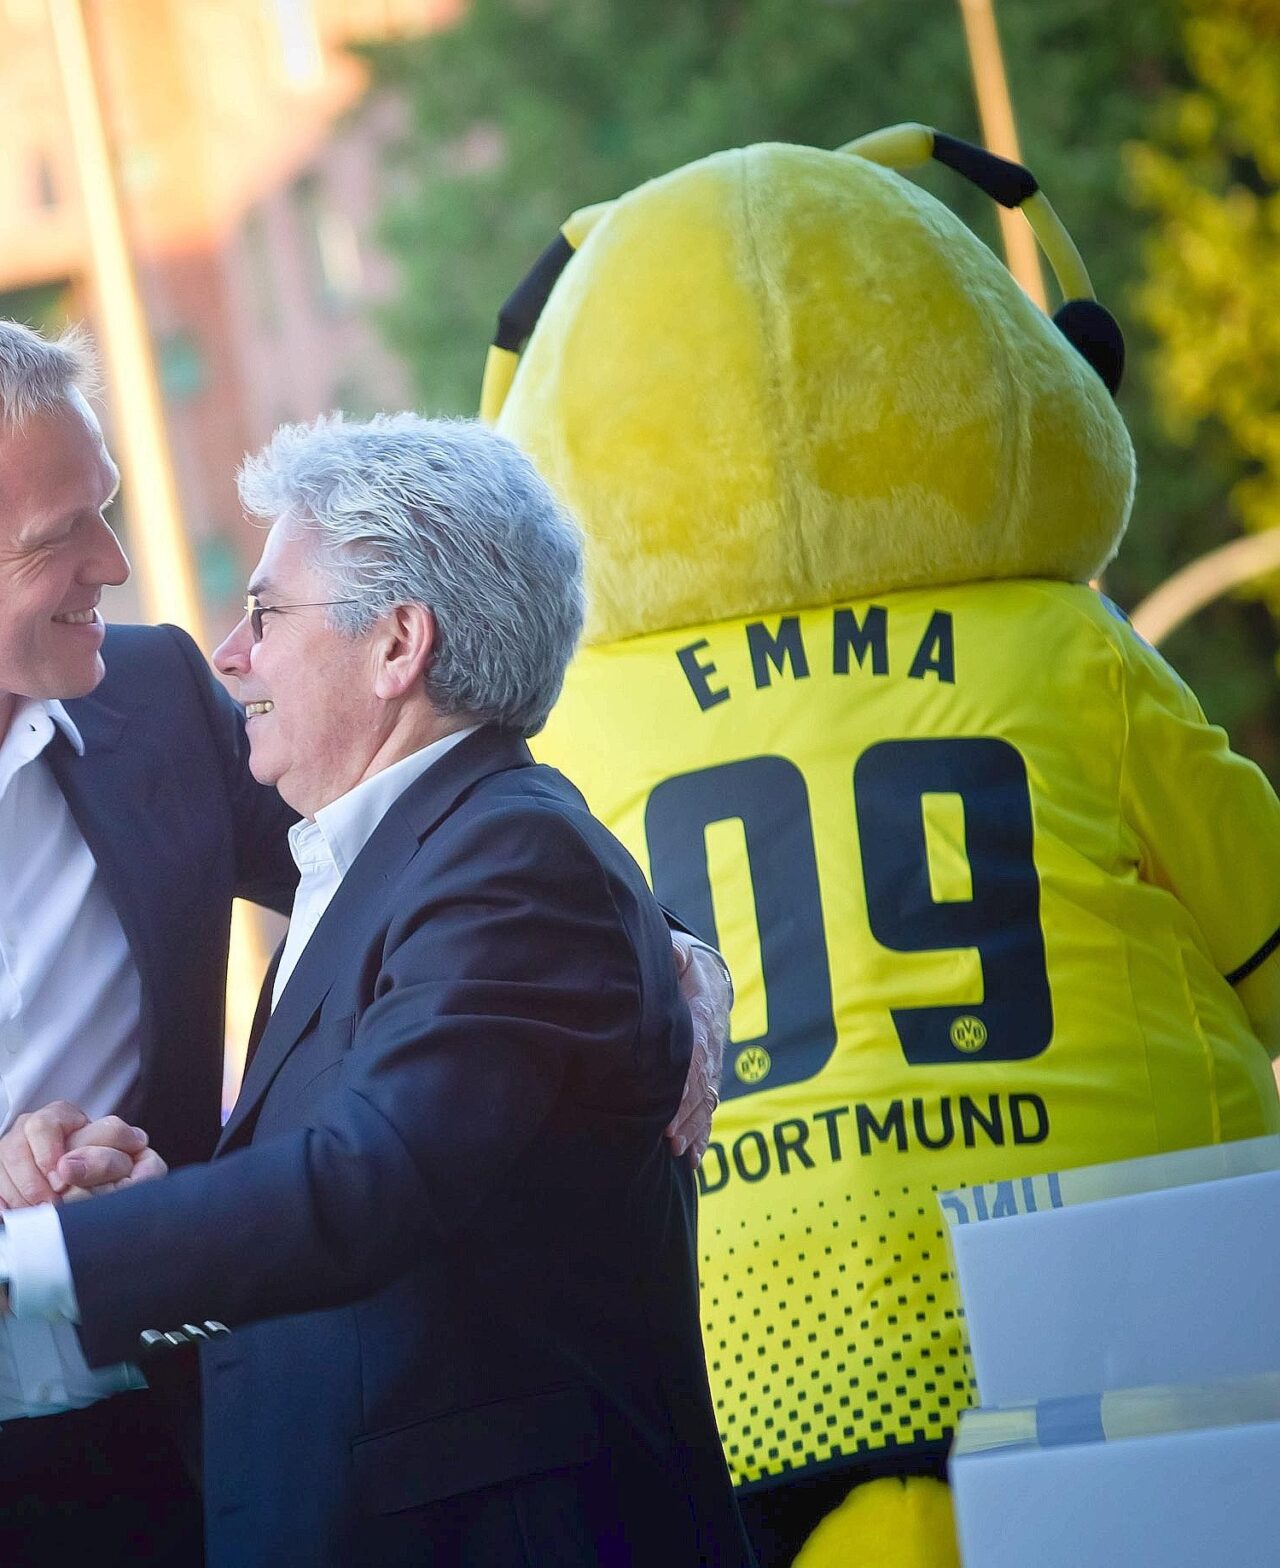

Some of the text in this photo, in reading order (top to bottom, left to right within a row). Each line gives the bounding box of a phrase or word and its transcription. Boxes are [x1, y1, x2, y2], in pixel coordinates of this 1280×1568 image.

[676, 604, 956, 712] EMMA
[644, 736, 1054, 1101] 09
[697, 1092, 1050, 1196] DORTMUND
